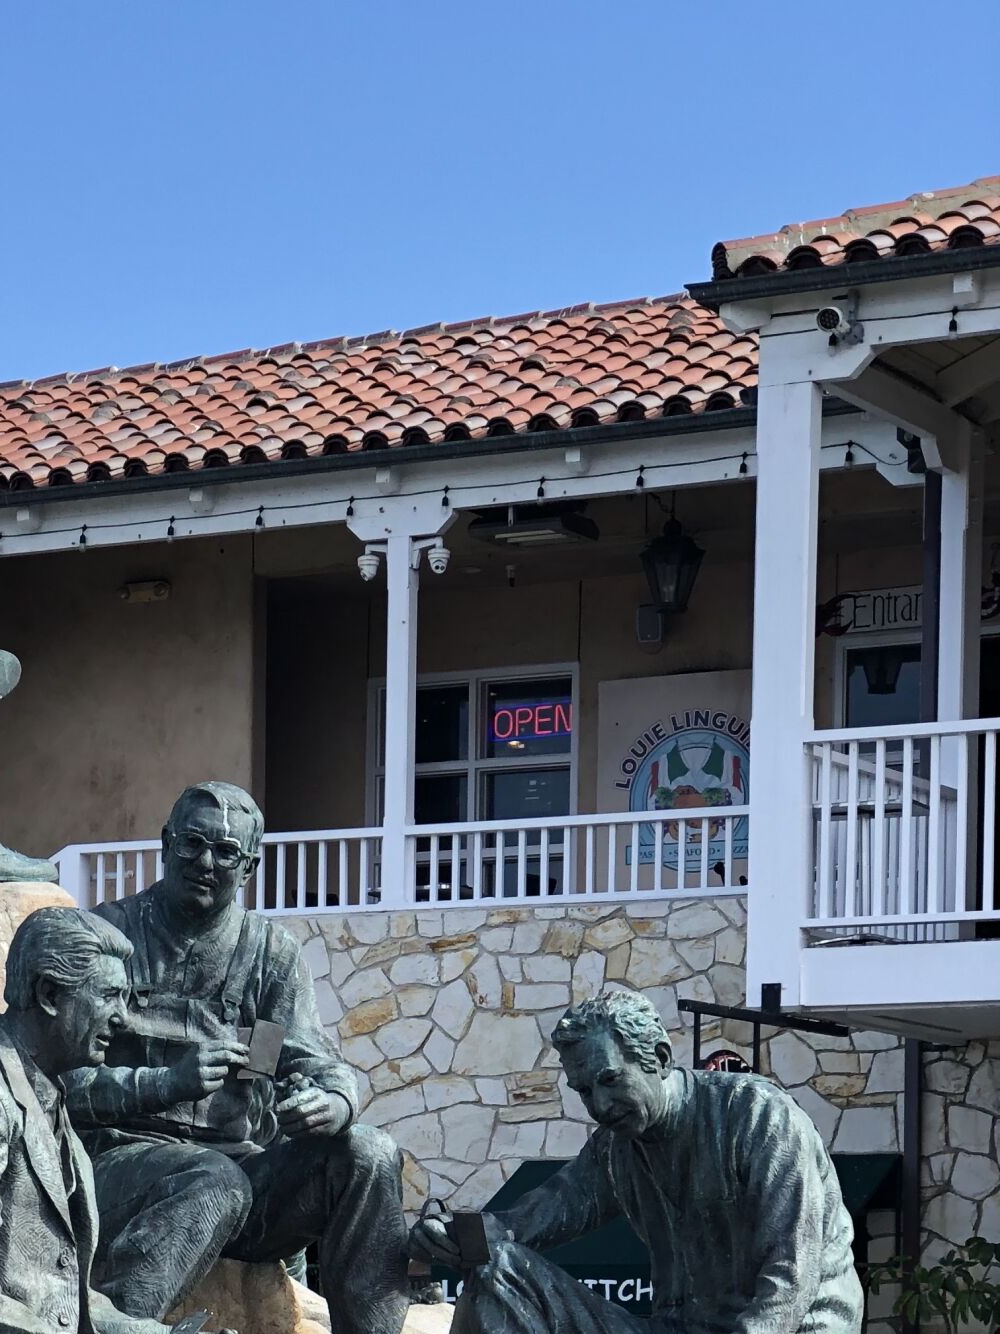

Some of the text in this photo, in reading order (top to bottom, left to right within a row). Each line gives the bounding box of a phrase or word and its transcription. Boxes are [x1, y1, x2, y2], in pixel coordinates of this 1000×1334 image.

[494, 703, 573, 739] OPEN
[615, 710, 751, 790] LOUIE LINGUI
